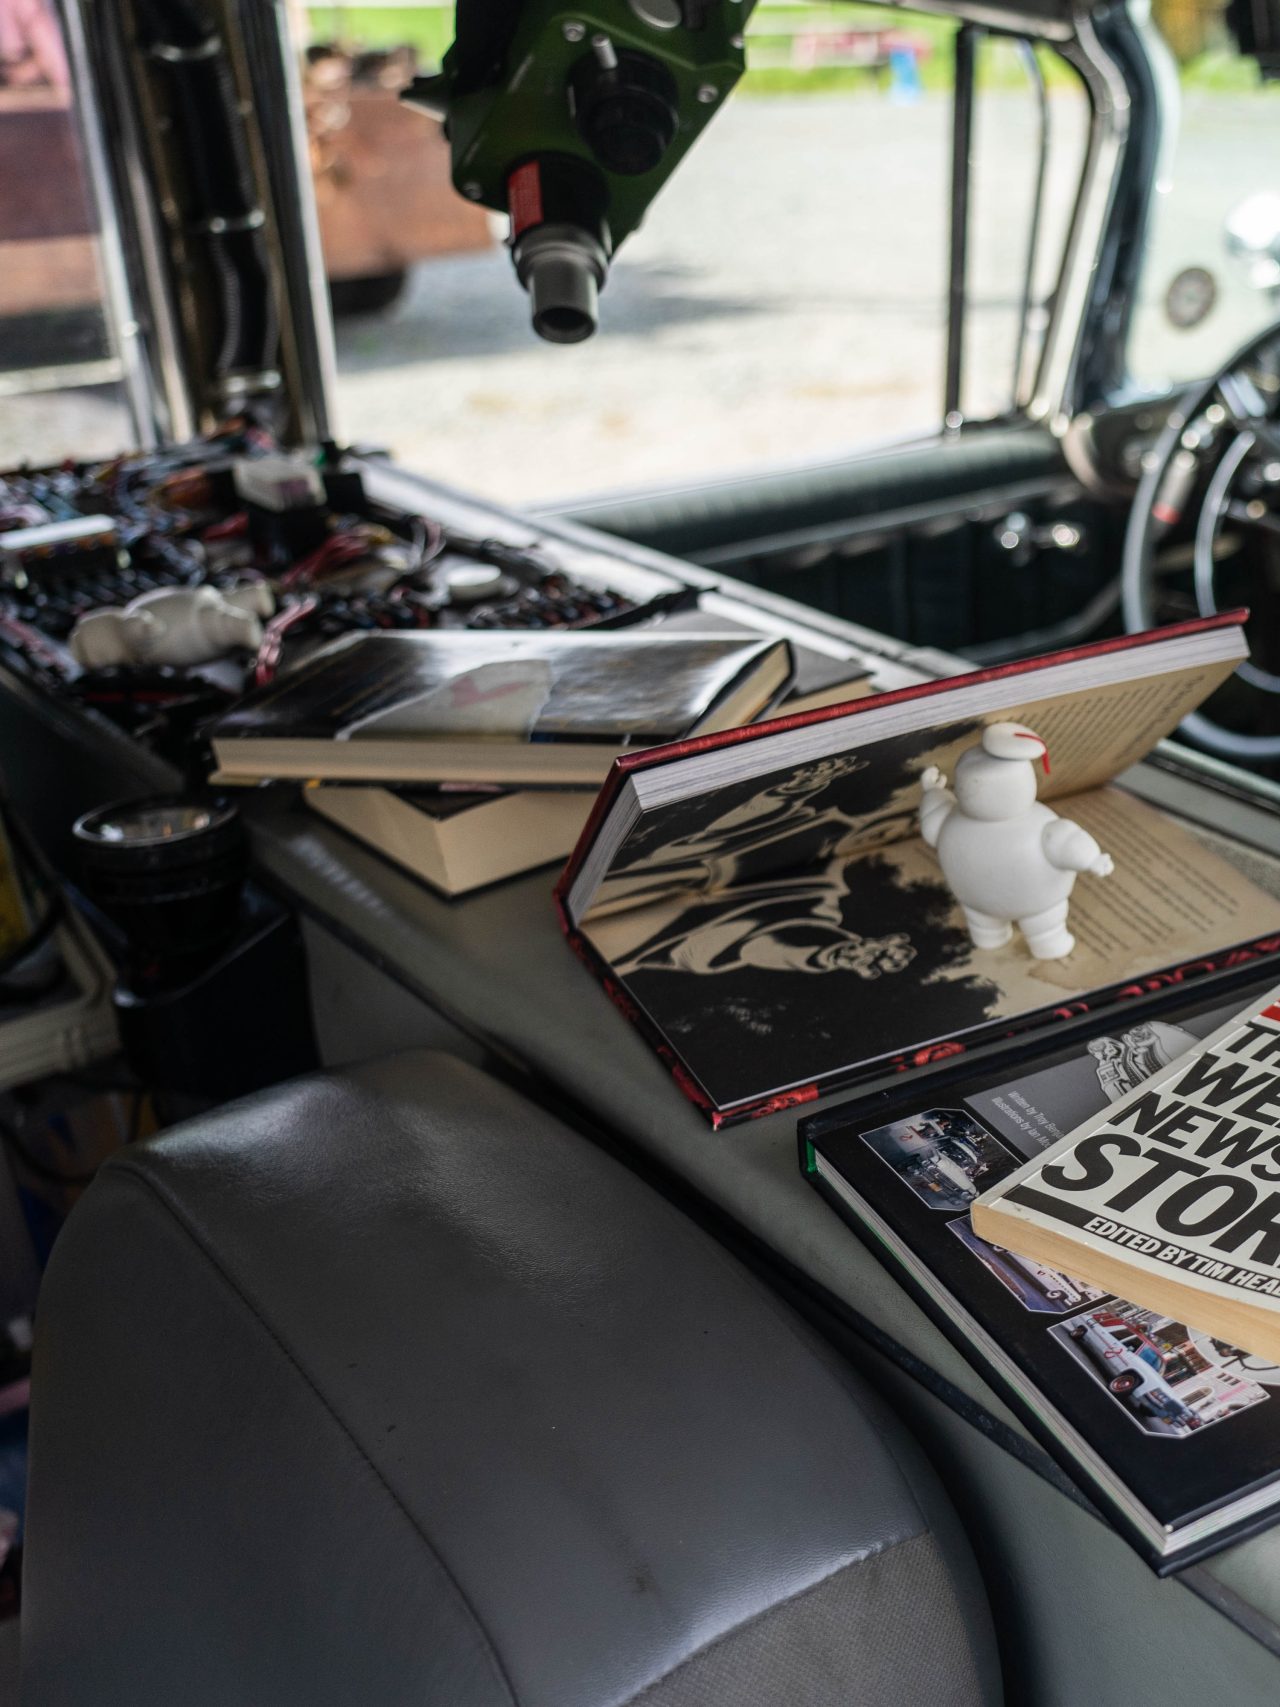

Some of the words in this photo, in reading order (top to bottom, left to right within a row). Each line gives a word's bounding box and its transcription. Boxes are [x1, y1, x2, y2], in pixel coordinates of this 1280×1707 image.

[1007, 1090, 1030, 1109] Written
[1025, 1106, 1038, 1115] by
[1020, 1121, 1033, 1130] by
[1083, 1216, 1162, 1253] EDITED
[1155, 1245, 1195, 1267] BY
[1188, 1255, 1234, 1280] TIM
